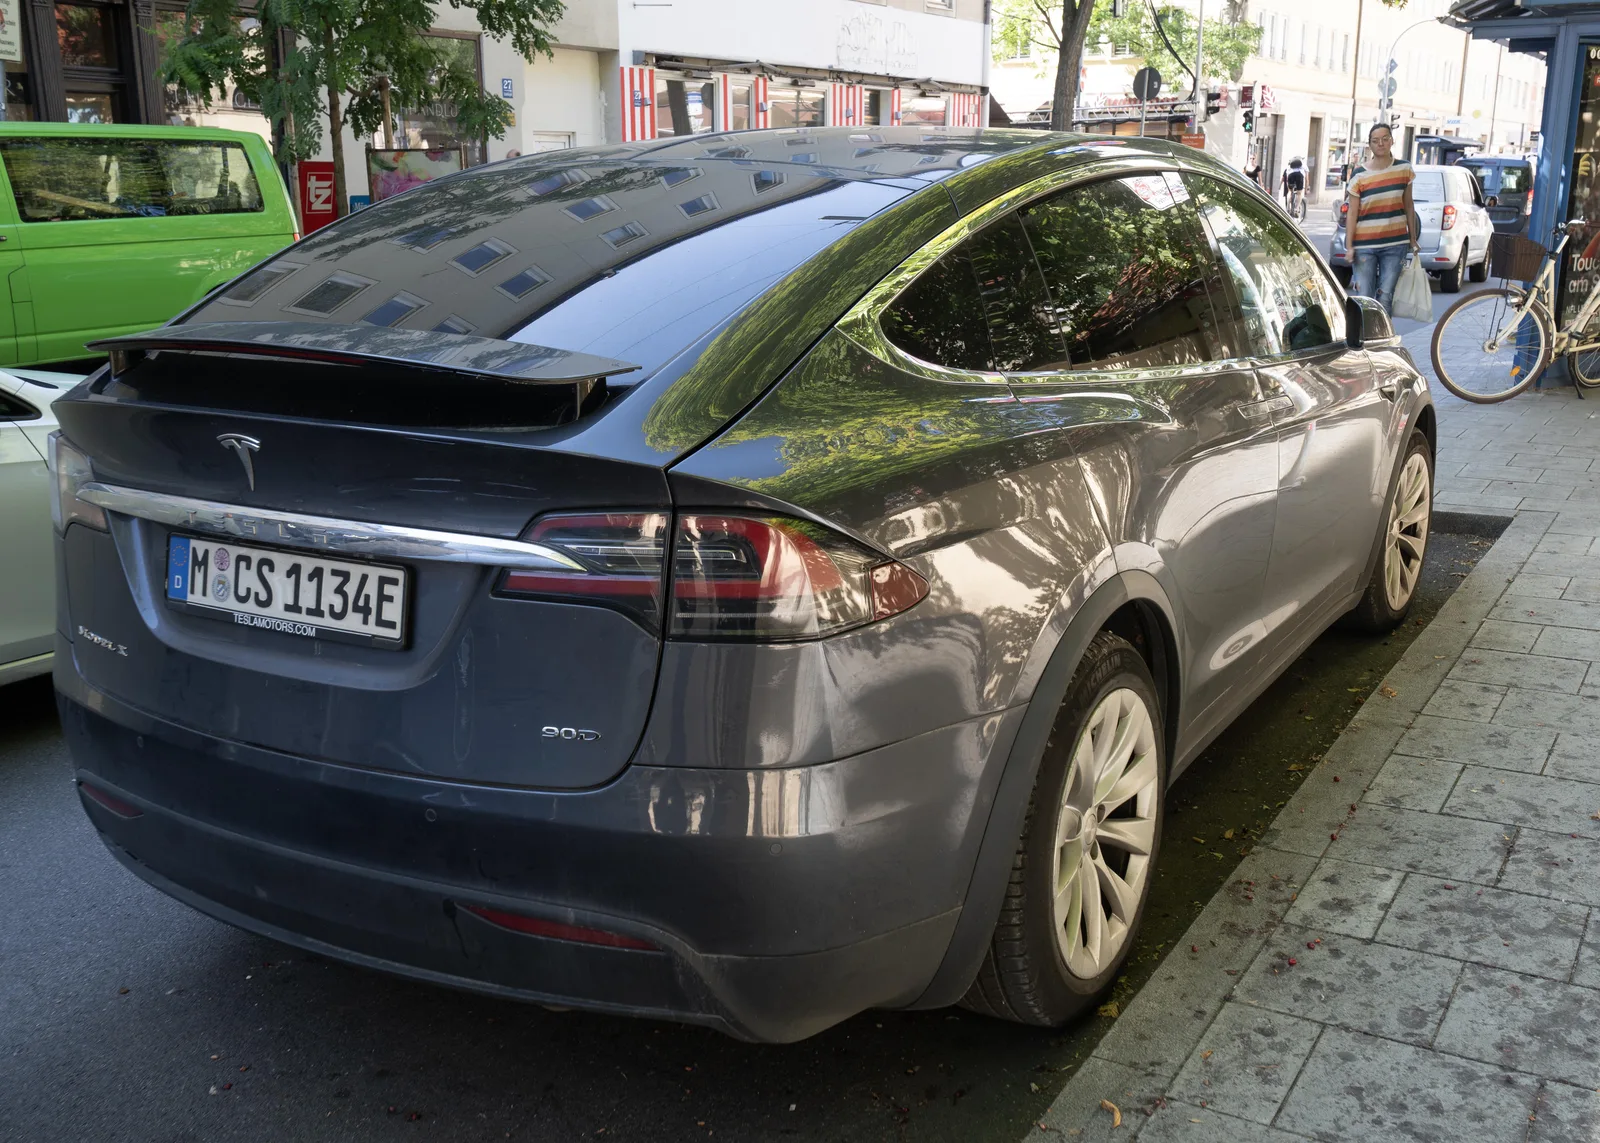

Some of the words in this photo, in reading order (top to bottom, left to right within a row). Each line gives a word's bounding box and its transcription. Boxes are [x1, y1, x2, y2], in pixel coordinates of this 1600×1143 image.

[503, 79, 512, 90] 27
[308, 175, 333, 211] tz
[187, 509, 328, 545] TESLA
[173, 574, 182, 589] D
[189, 546, 210, 597] M
[233, 554, 275, 609] CS
[283, 562, 400, 630] 1134E
[233, 612, 316, 638] TESLAMOTORS.COM
[541, 726, 602, 741] 90D
